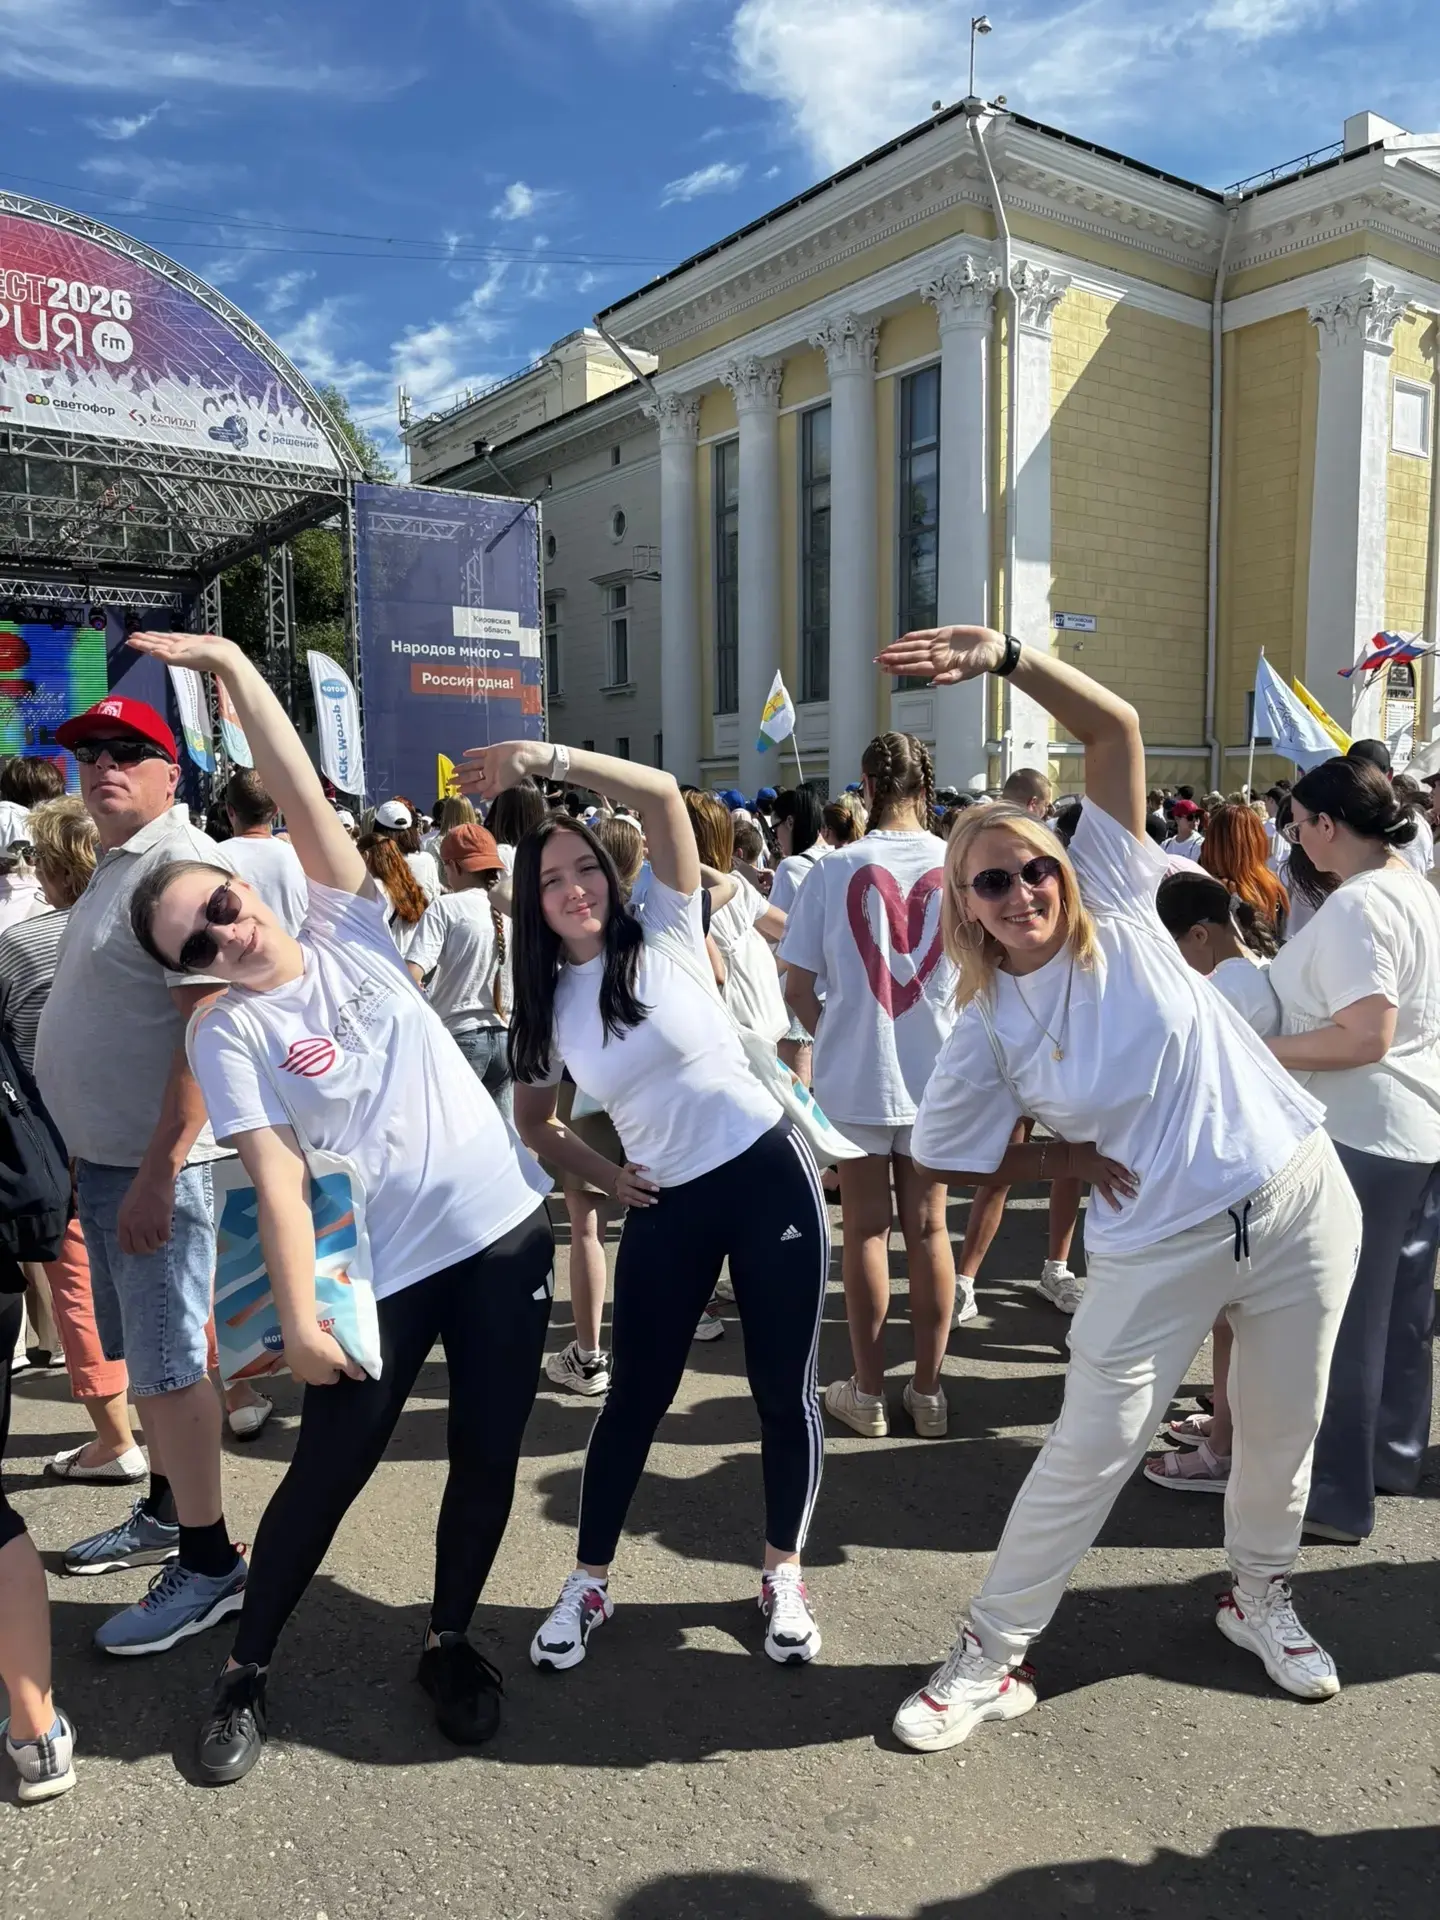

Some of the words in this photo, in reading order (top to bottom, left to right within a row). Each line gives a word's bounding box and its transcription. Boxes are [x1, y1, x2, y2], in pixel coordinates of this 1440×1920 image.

[0, 268, 133, 321] СТ2026
[52, 398, 116, 416] светофор
[150, 413, 197, 429] КАПИТАЛ
[272, 436, 319, 449] решение
[473, 615, 511, 624] Кировская
[484, 626, 511, 635] область
[391, 640, 456, 656] Народов
[459, 647, 501, 659] много
[422, 672, 474, 688] Россия
[477, 675, 514, 690] одна!
[780, 1232, 802, 1241] adidas
[264, 1334, 282, 1344] МОТ
